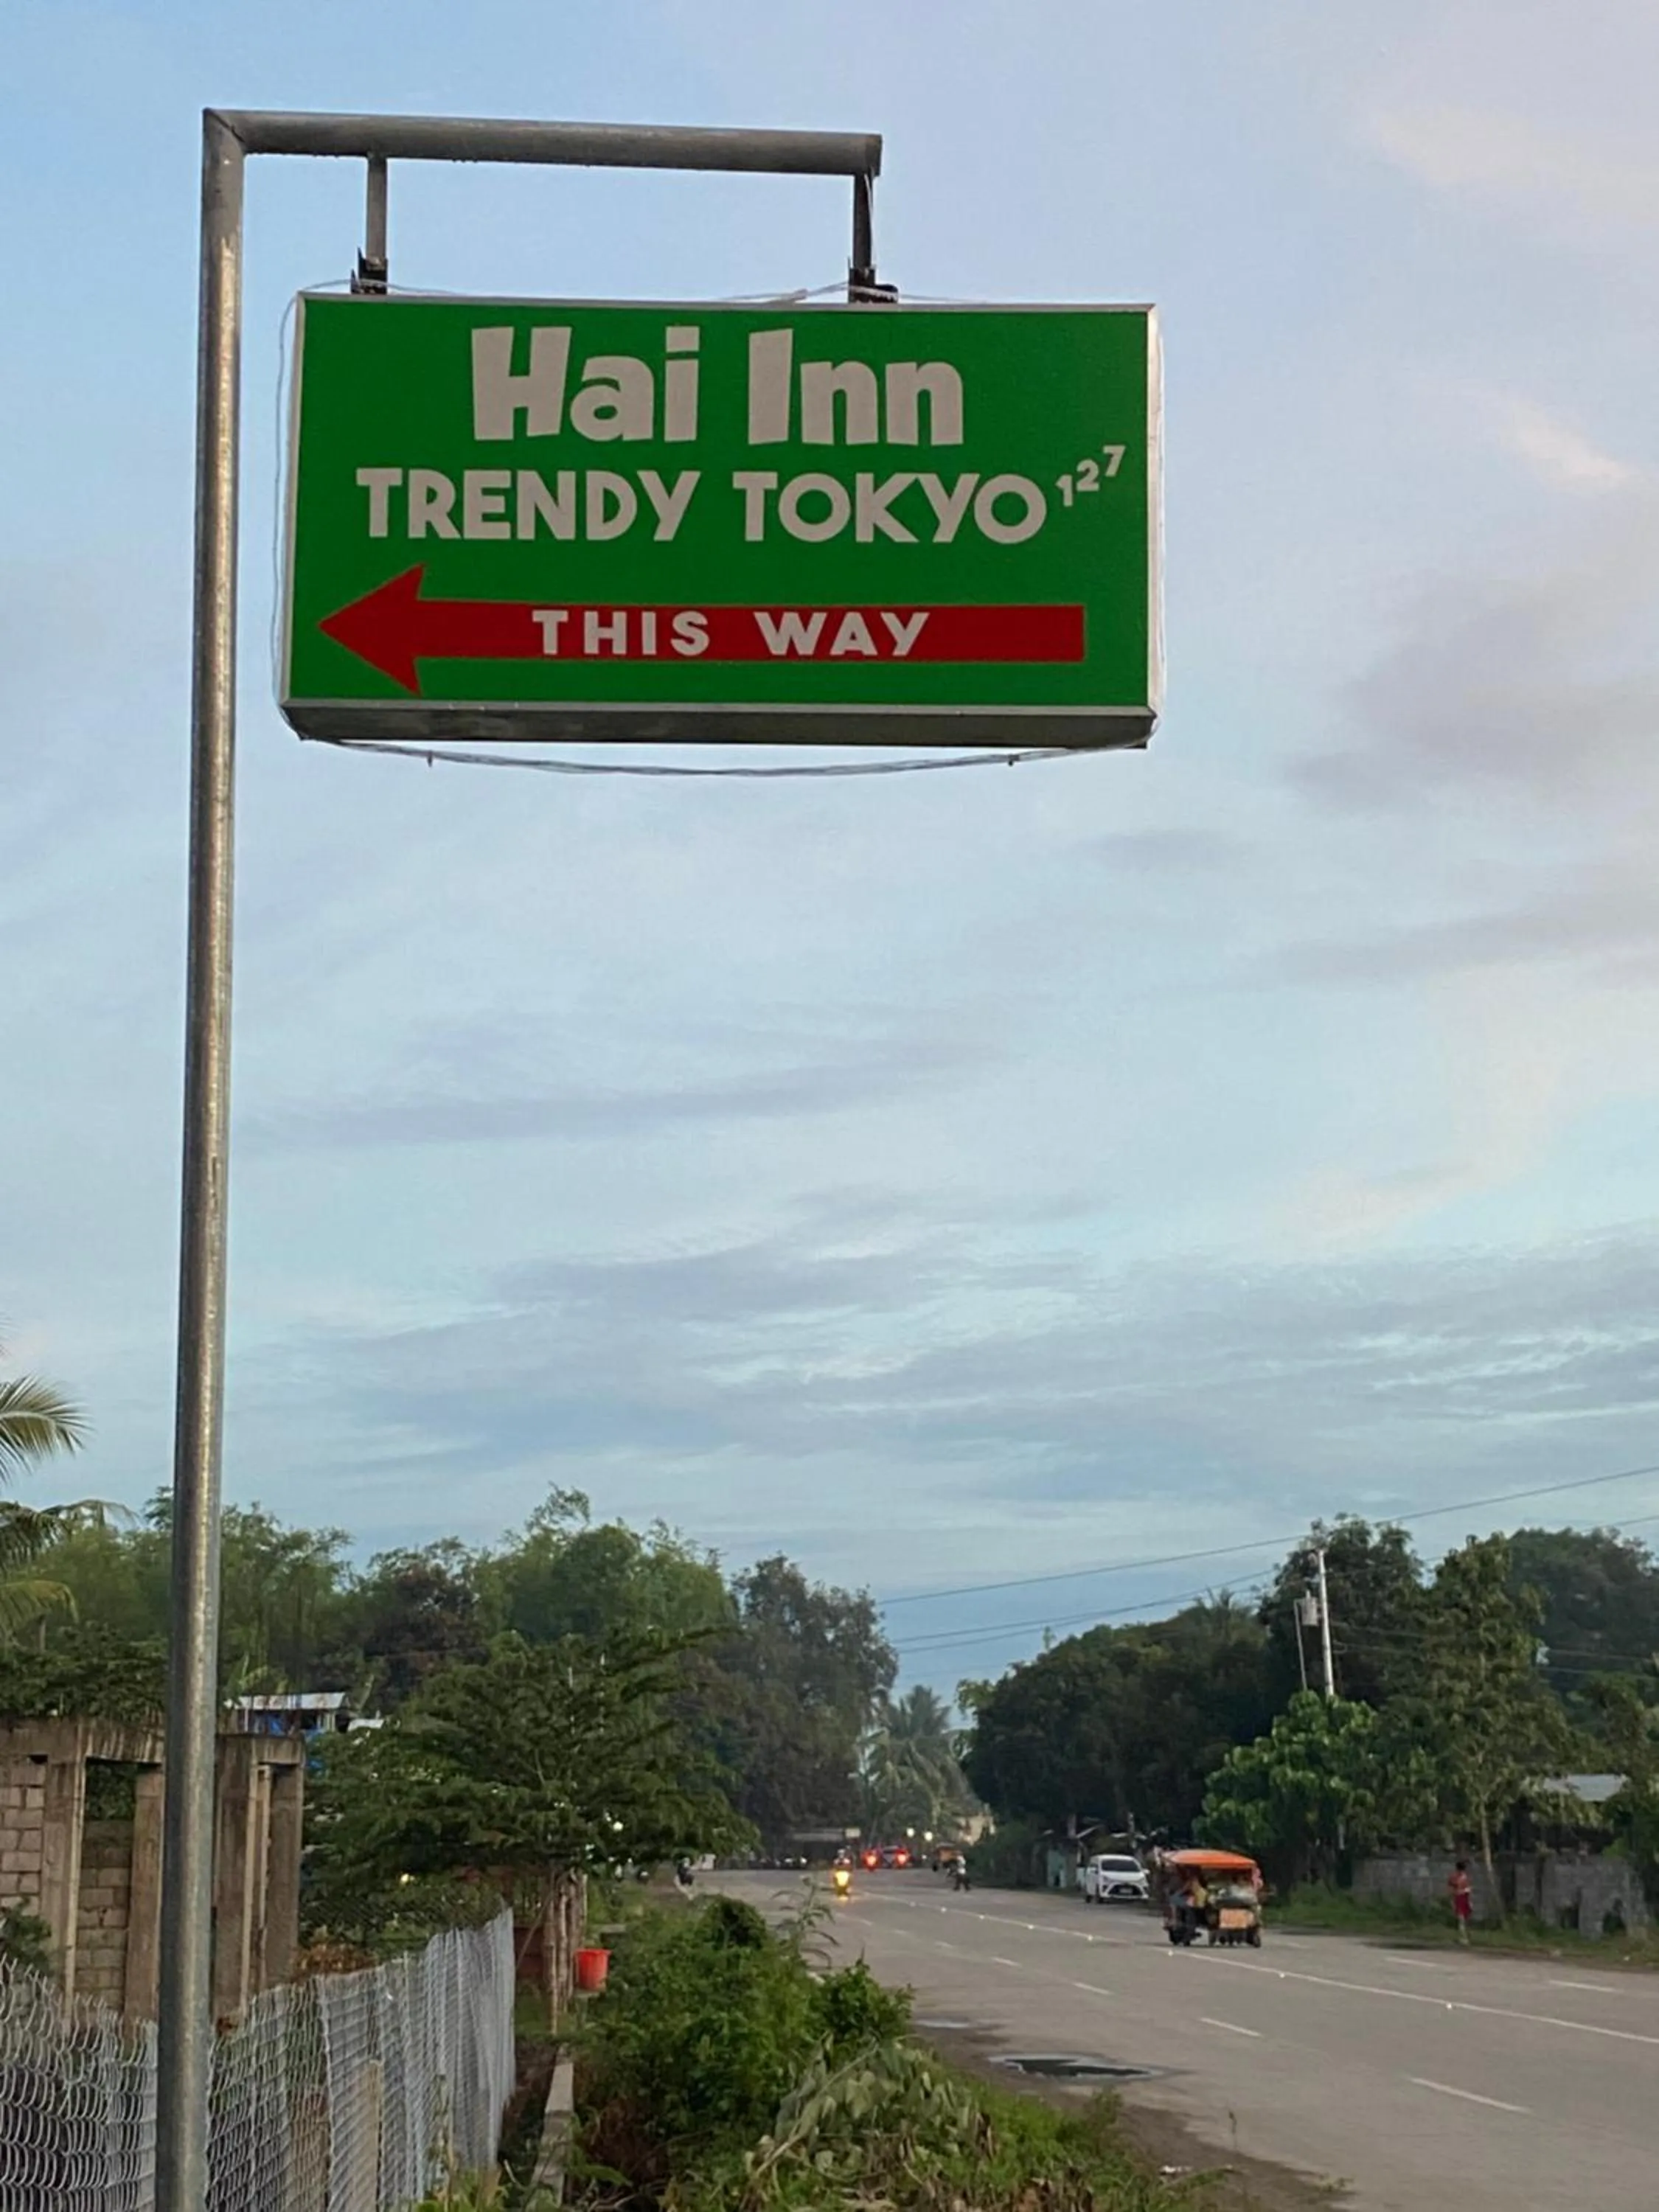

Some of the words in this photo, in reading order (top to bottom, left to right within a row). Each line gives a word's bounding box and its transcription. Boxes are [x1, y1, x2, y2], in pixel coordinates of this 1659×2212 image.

[471, 326, 700, 445] Hai
[748, 328, 964, 446] Inn
[356, 467, 700, 542] TRENDY
[732, 471, 1047, 544] TOKYO
[532, 610, 709, 655] THIS
[754, 612, 930, 656] WAY
